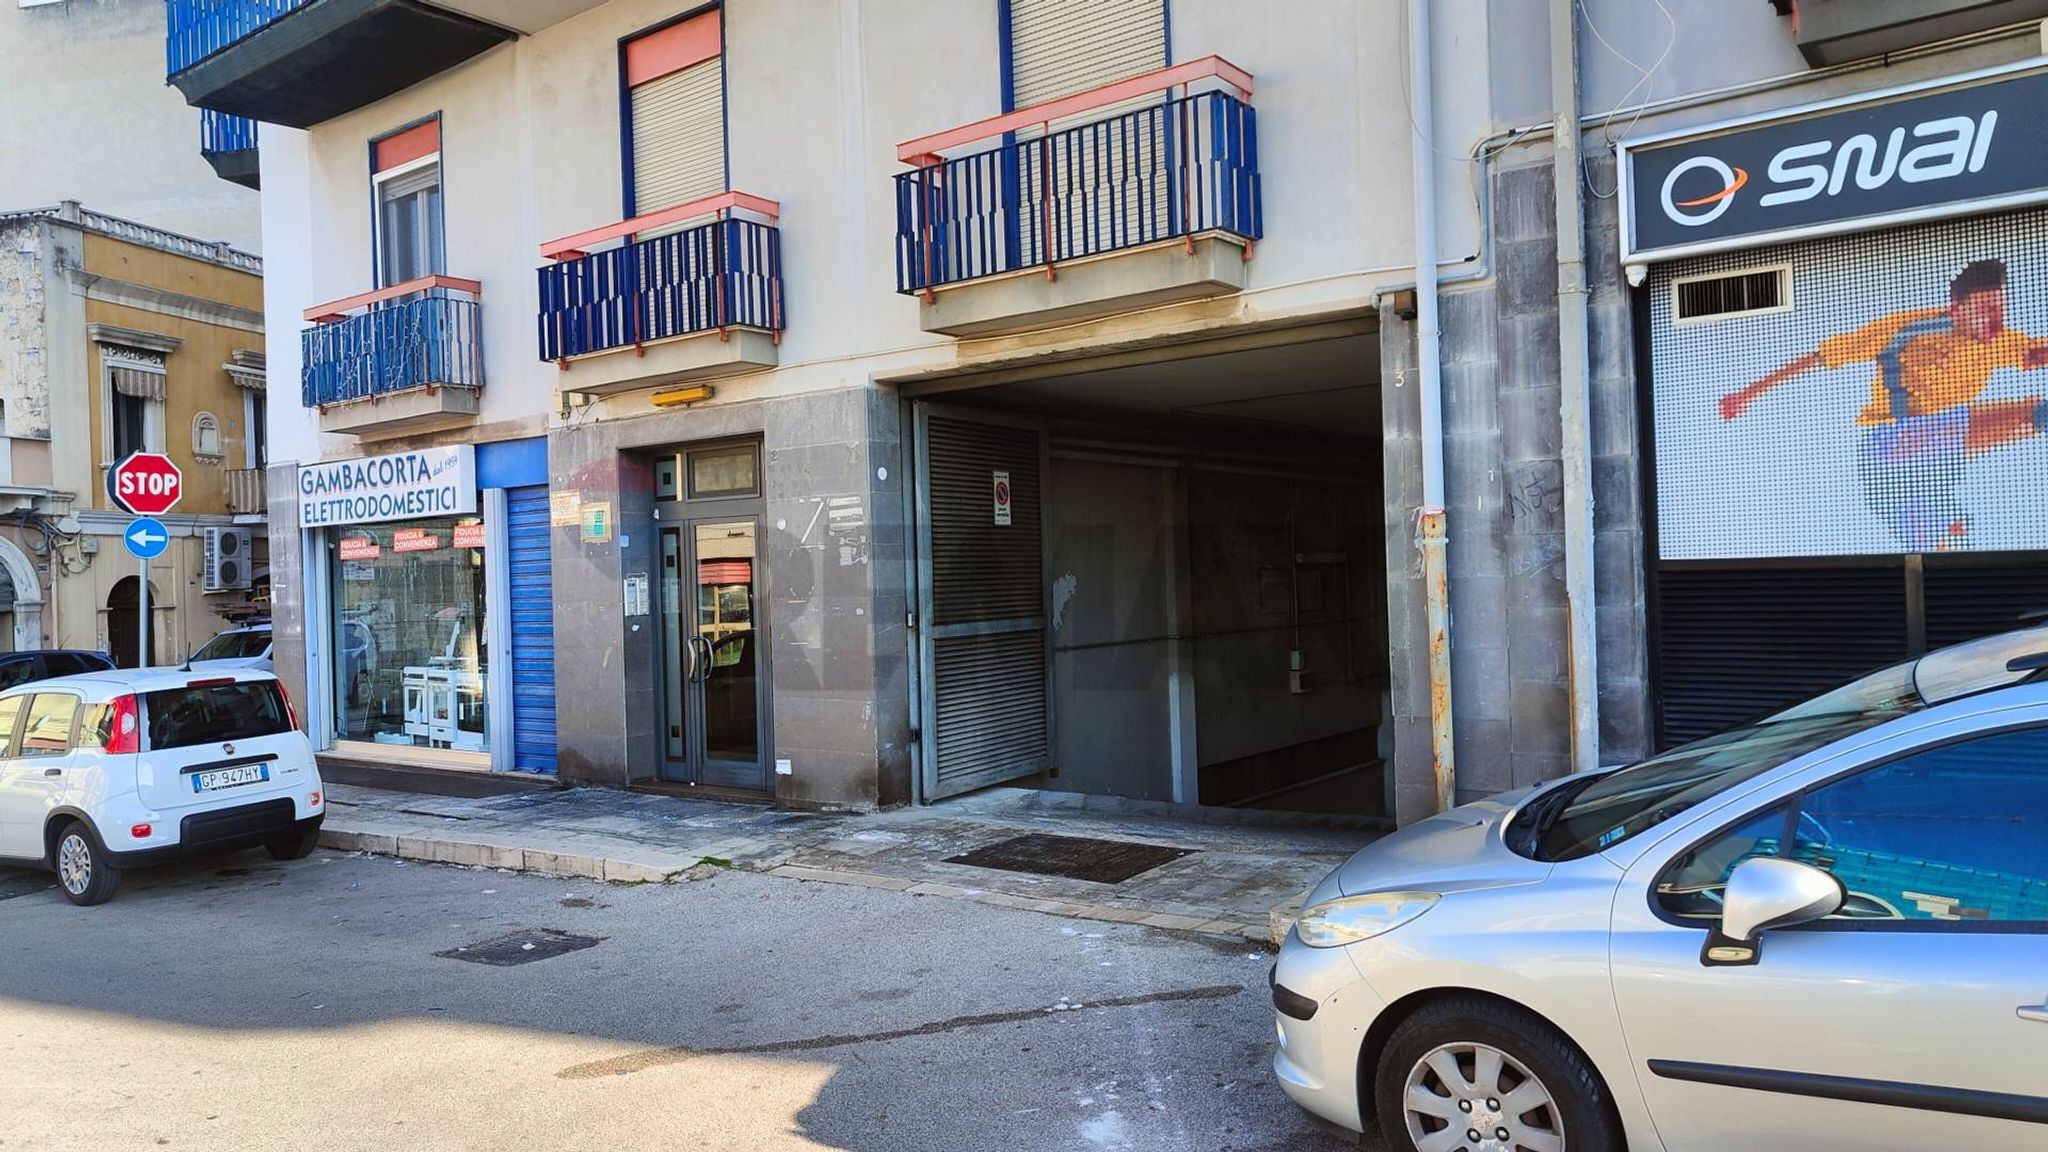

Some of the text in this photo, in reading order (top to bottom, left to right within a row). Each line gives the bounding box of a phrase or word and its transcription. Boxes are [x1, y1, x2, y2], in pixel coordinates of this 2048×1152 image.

[121, 471, 178, 496] STOP
[301, 454, 432, 494] GAMBACORTA
[304, 486, 456, 524] ELETTRODOMESTICI
[202, 773, 217, 788] GP
[222, 767, 259, 784] 947HY
